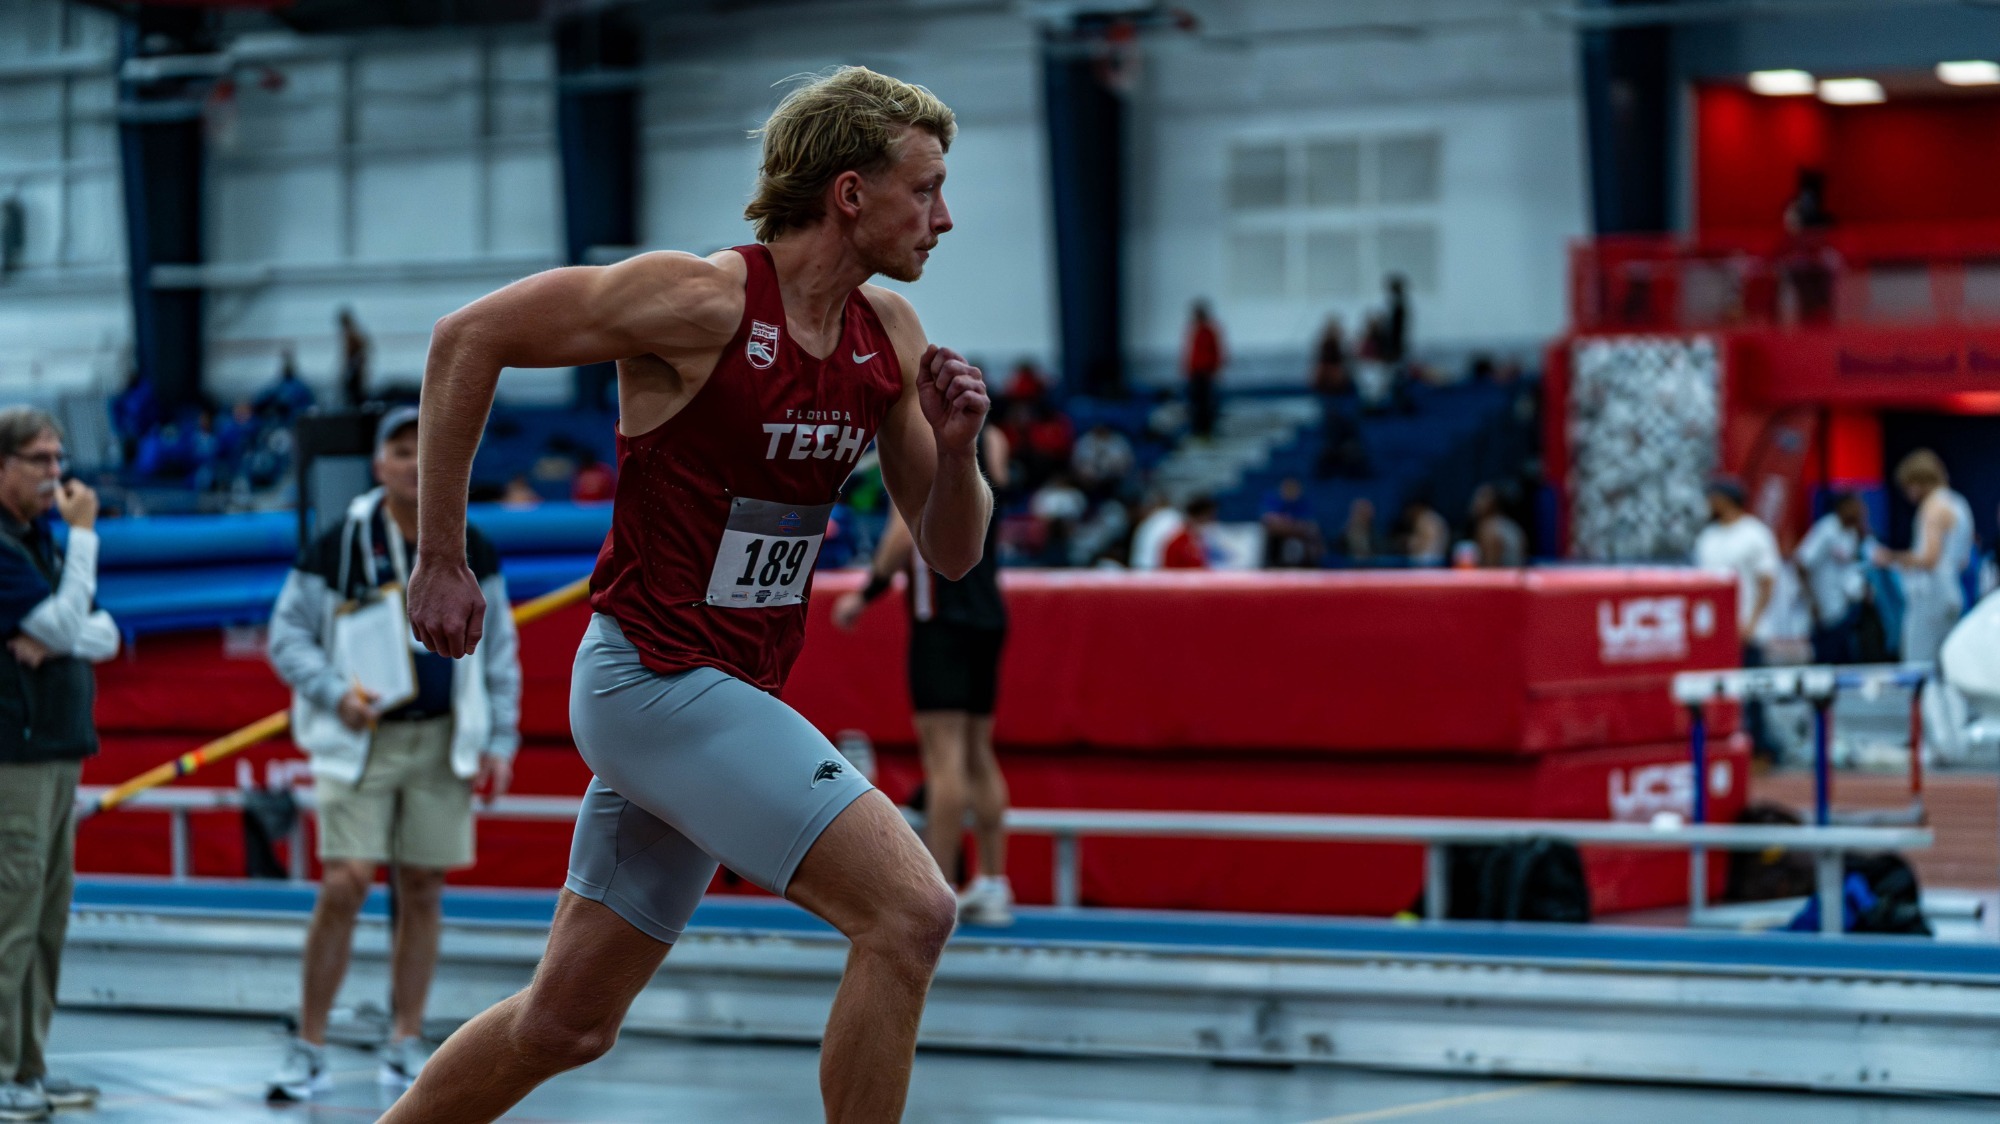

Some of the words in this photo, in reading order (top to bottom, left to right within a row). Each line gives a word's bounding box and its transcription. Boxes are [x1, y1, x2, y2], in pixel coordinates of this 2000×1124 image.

[786, 409, 851, 421] FLORIDA
[762, 423, 865, 463] TECH
[736, 538, 809, 587] 189
[1598, 597, 1687, 643] UCS
